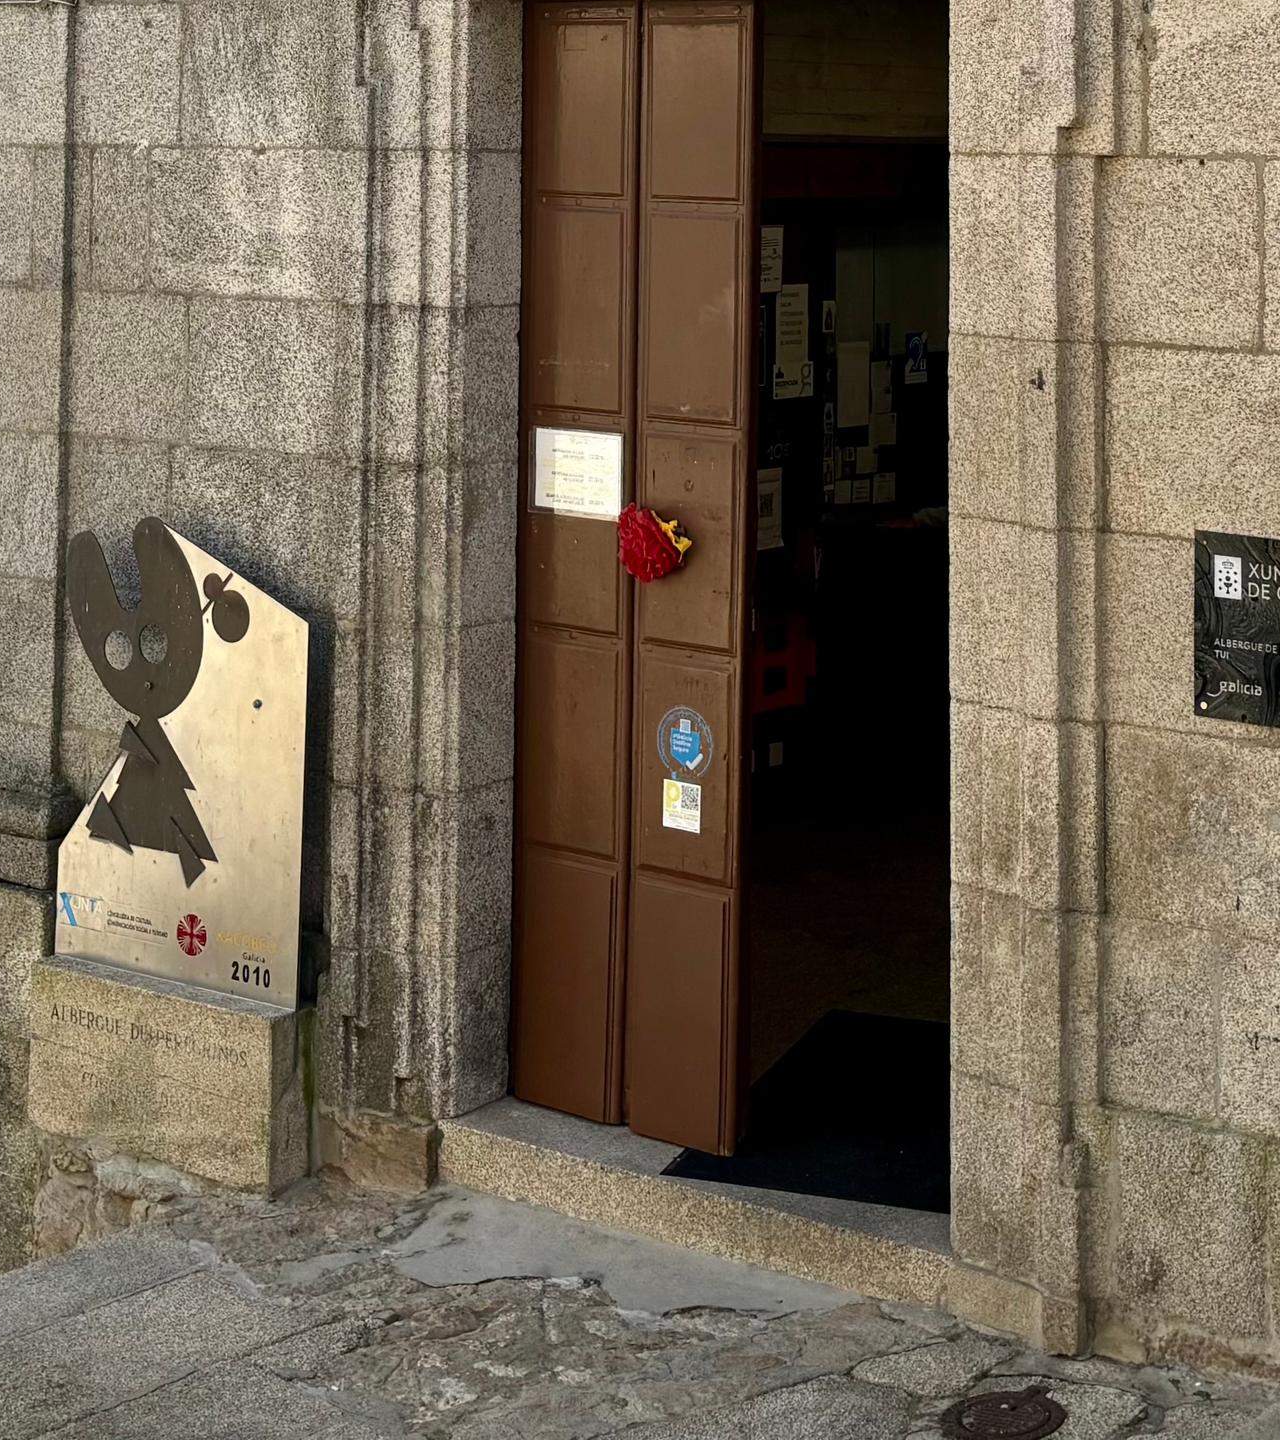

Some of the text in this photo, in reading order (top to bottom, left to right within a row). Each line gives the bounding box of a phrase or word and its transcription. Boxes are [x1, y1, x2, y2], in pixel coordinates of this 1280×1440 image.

[1248, 582, 1271, 600] DE
[1214, 638, 1263, 652] ALBERGUE
[1265, 643, 1278, 654] DE
[1215, 649, 1229, 660] TUI
[1207, 679, 1263, 698] galicia
[59, 892, 104, 926] XUNTA
[242, 952, 266, 964] Galicia
[231, 960, 271, 988] 2010
[50, 1003, 121, 1036] ALBERGUE
